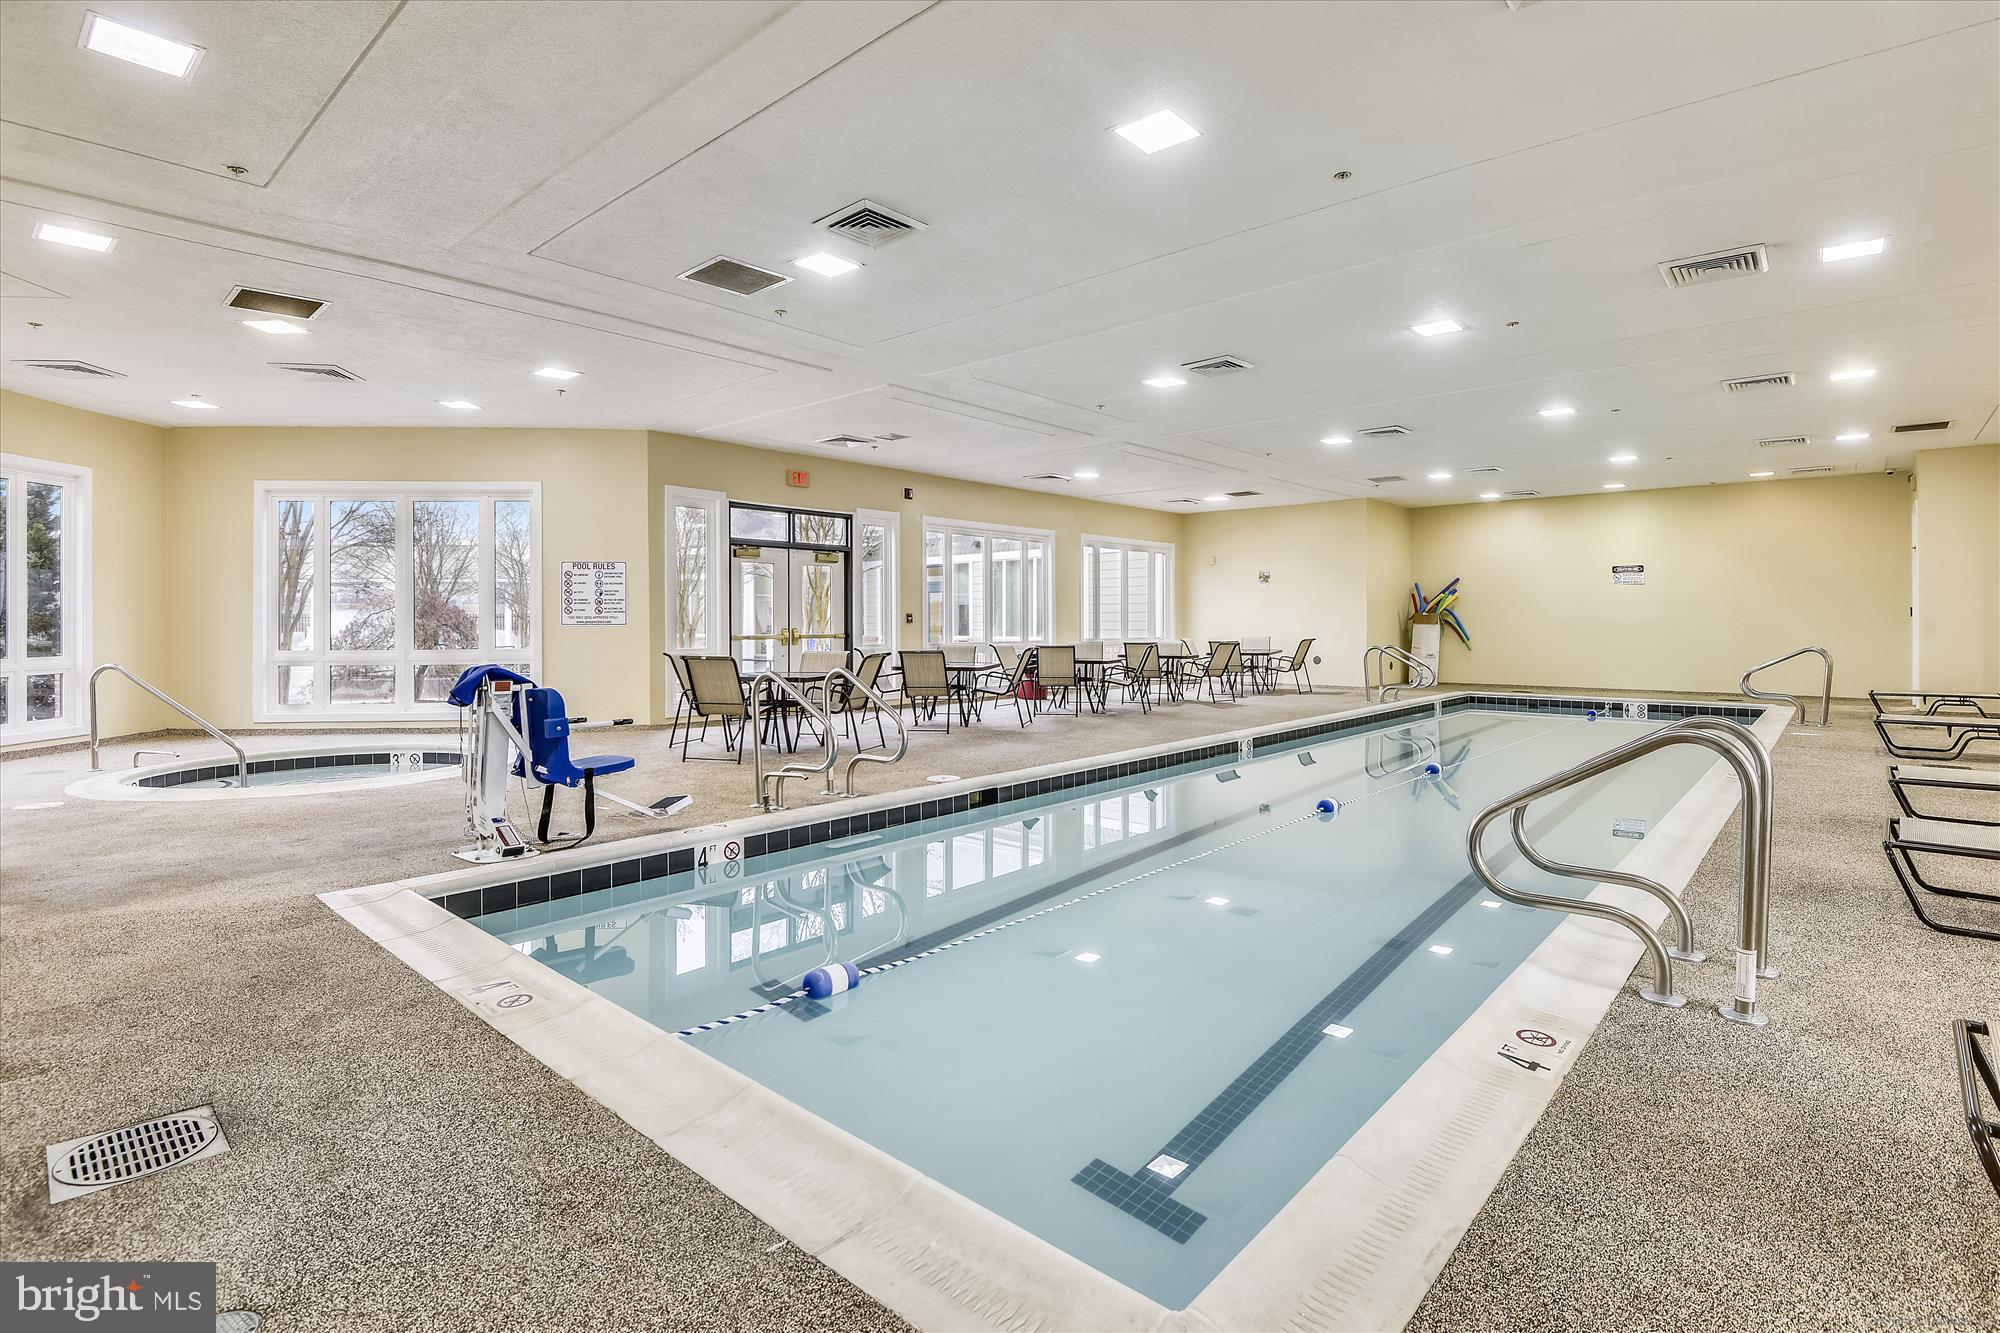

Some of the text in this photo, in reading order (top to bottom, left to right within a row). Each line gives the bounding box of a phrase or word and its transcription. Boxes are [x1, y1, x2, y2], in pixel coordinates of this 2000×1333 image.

[572, 562, 616, 570] POOL RULES
[697, 844, 717, 868] 4 FT
[1496, 1051, 1552, 1072] 4
